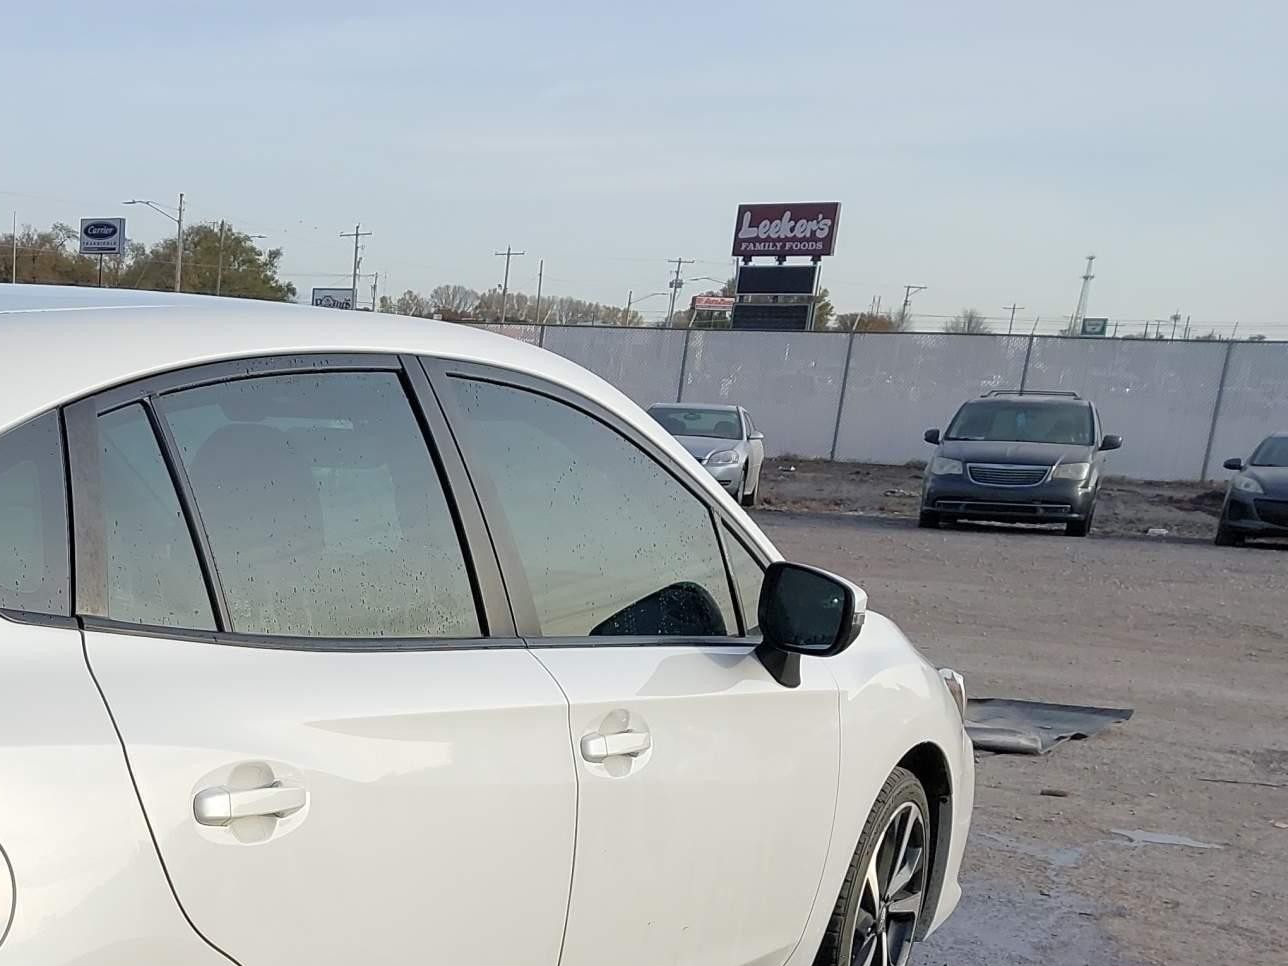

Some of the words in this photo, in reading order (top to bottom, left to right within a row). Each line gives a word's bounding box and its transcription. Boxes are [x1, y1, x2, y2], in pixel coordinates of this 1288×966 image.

[88, 225, 114, 234] Carrier
[738, 211, 832, 239] Leeker's
[740, 242, 782, 251] FAMILY
[784, 241, 823, 250] FOODS
